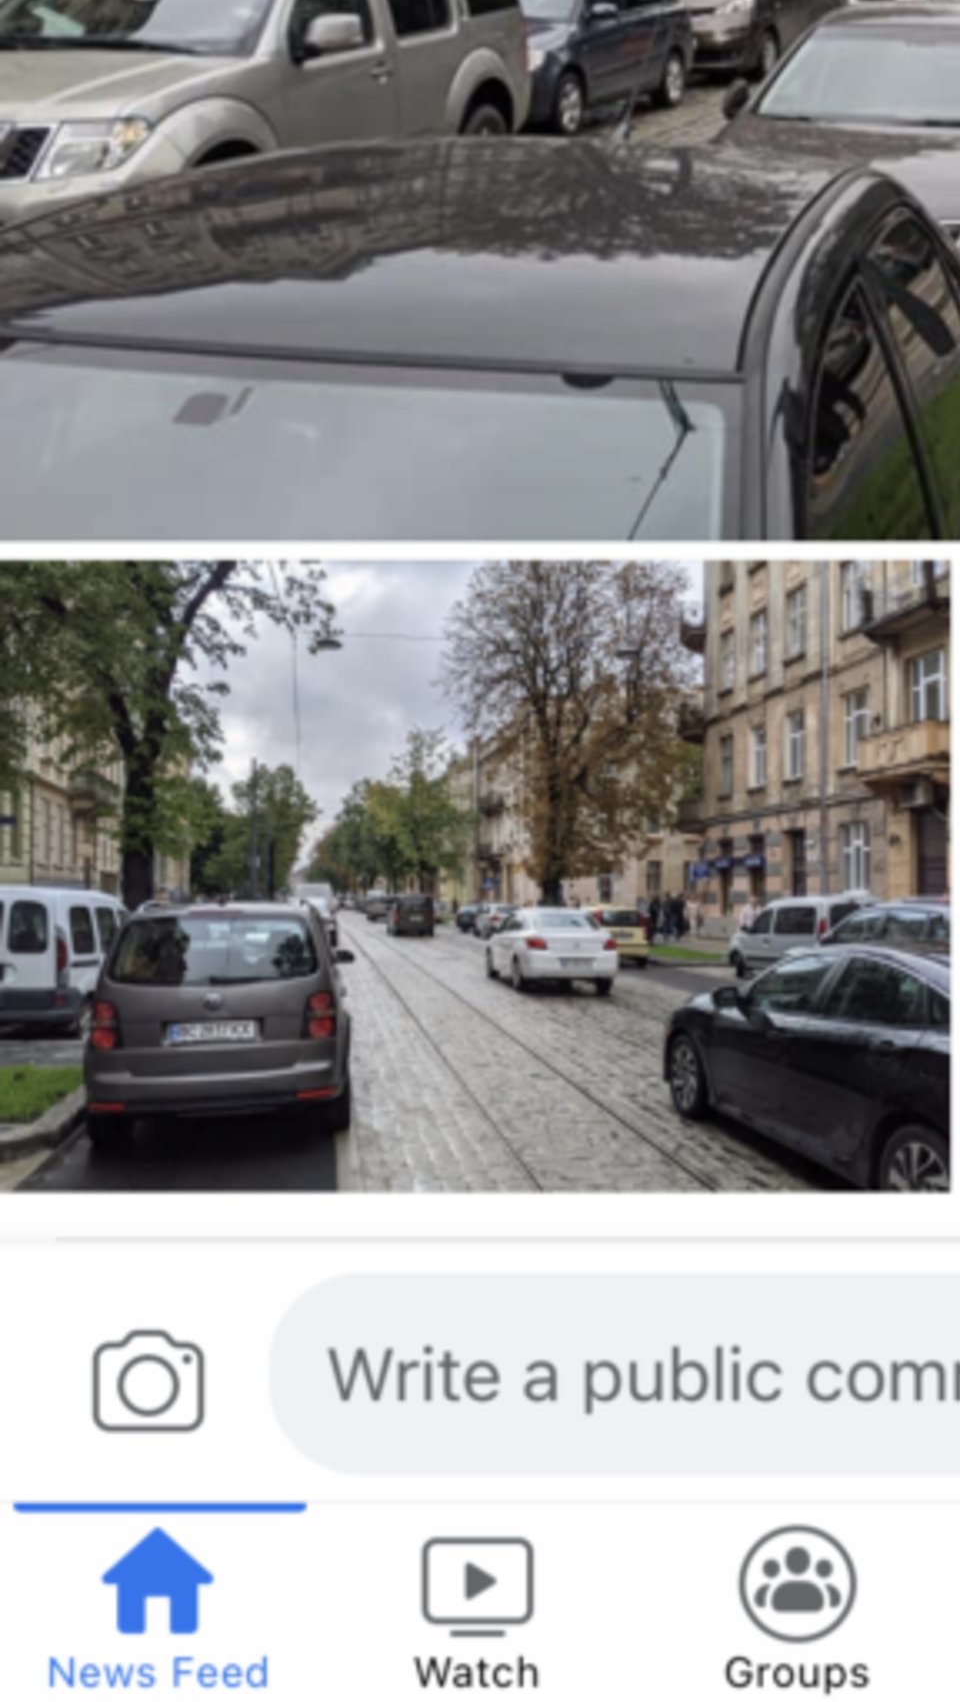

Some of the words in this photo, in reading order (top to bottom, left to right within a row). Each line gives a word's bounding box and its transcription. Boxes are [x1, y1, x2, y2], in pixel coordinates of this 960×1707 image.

[327, 1344, 501, 1403] Write
[523, 1359, 558, 1403] a
[584, 1344, 782, 1416] public
[47, 1655, 157, 1690] News
[171, 1654, 269, 1690] Feed
[412, 1654, 540, 1690] Watch
[723, 1654, 871, 1696] Groups
